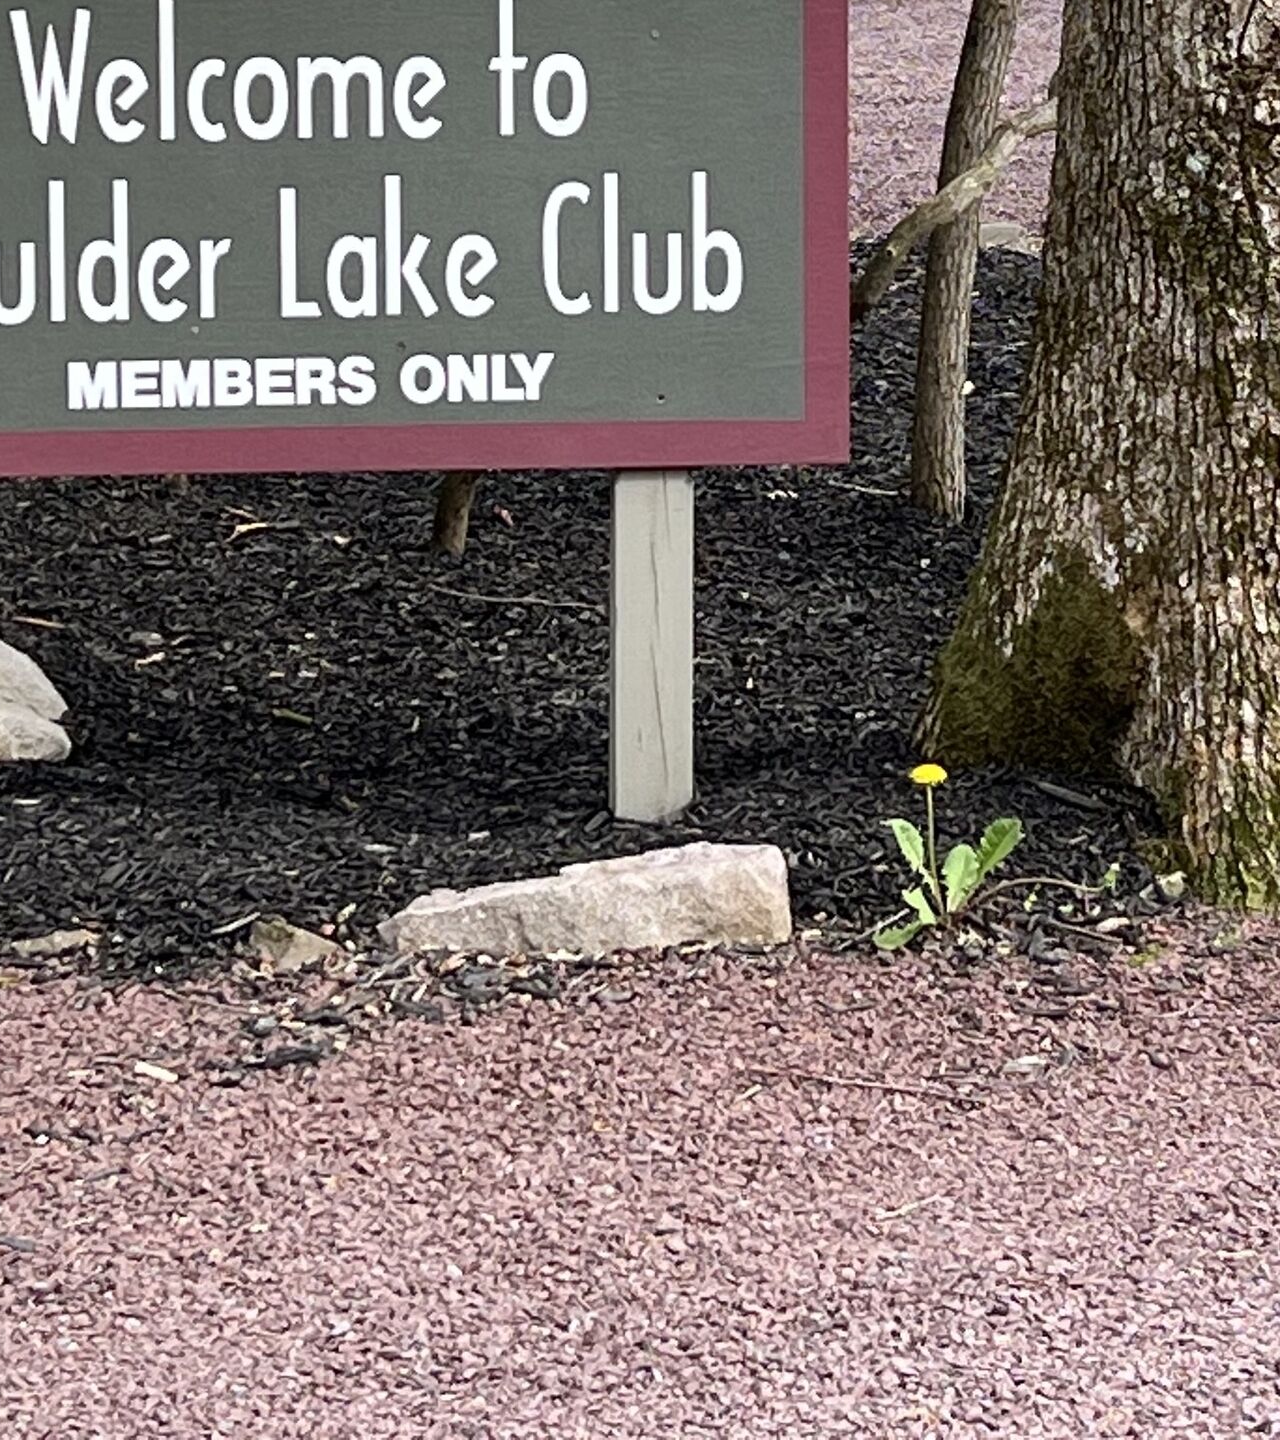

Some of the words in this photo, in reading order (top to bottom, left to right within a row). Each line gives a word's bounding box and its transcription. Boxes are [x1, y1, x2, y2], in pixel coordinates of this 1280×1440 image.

[279, 174, 498, 319] Lake
[542, 171, 743, 315] Club
[67, 355, 377, 410] MEMBERS
[399, 352, 555, 405] ONLY
